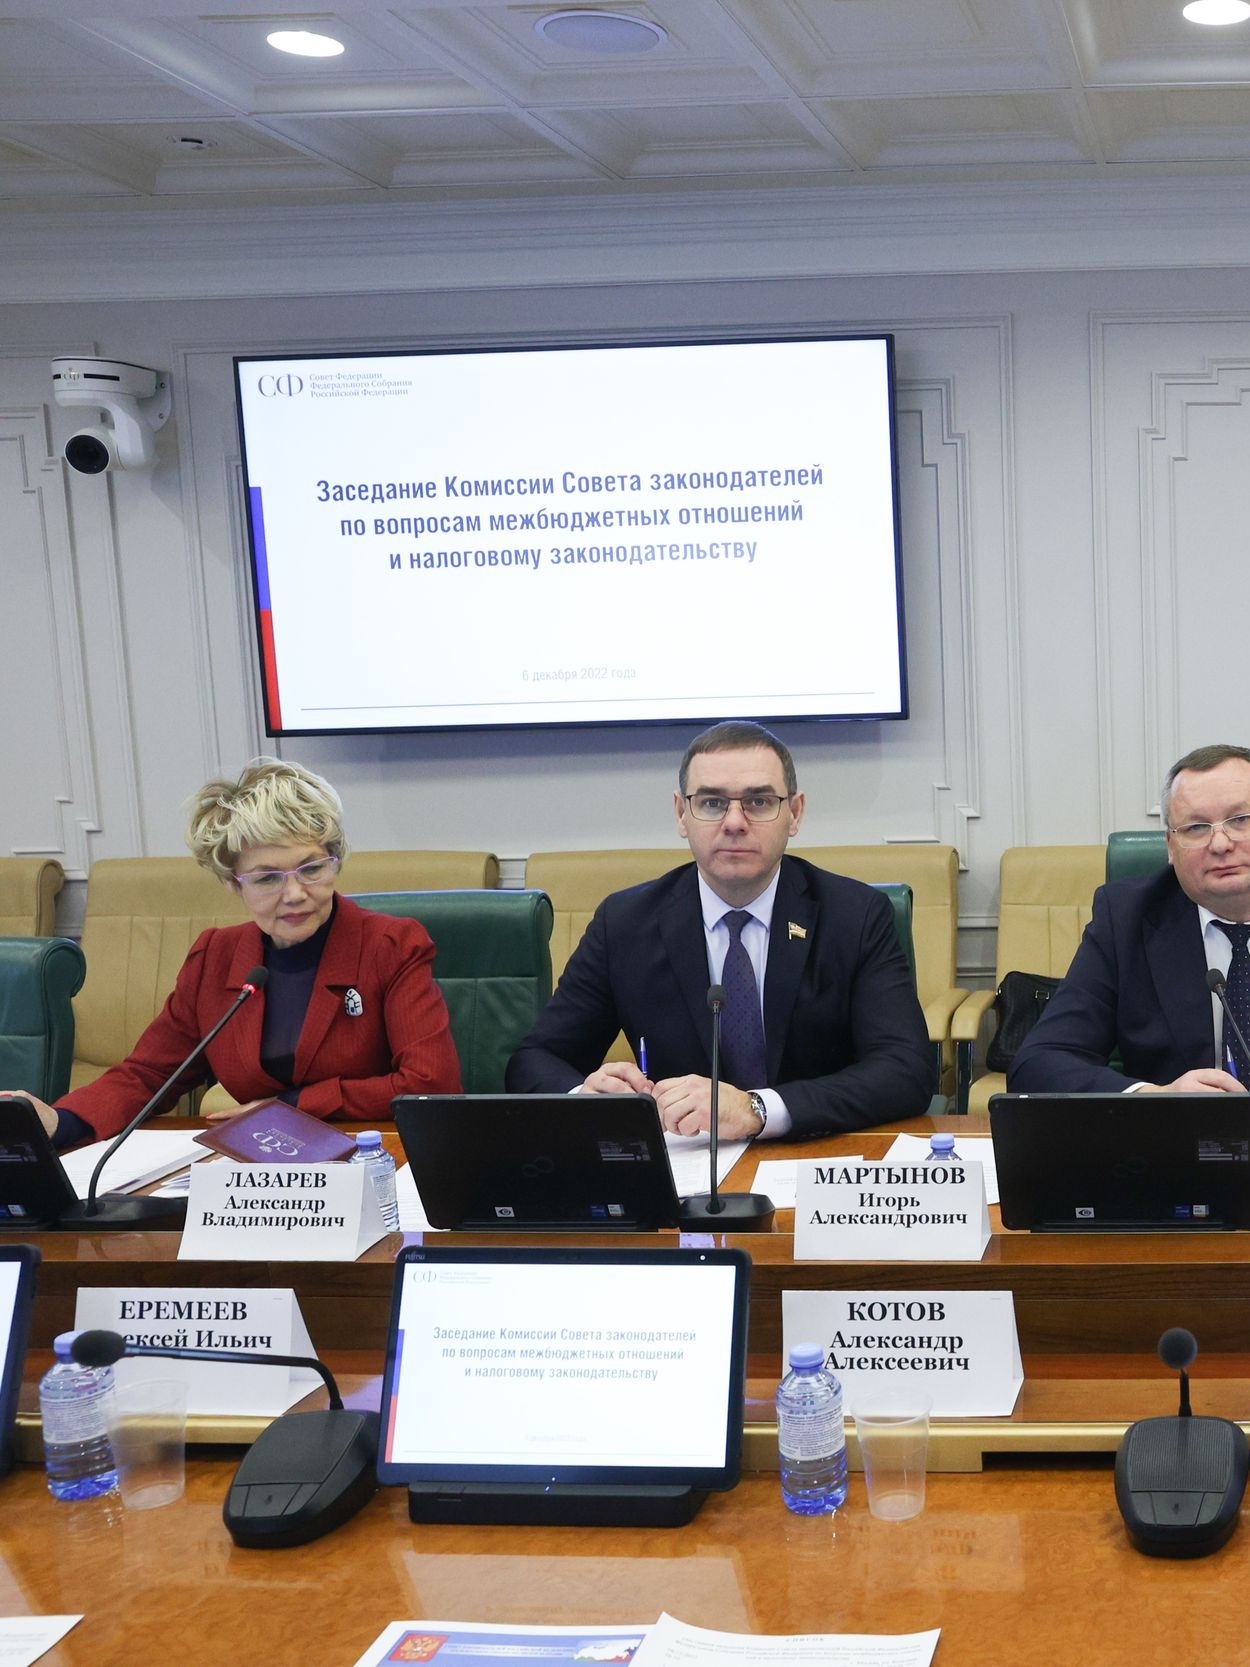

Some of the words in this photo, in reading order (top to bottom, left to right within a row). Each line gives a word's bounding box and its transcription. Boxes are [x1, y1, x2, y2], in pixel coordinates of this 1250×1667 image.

[258, 374, 303, 396] СФ
[317, 480, 436, 503] Заседание
[445, 476, 553, 497] Комиссии
[563, 472, 641, 493] Совета
[650, 464, 822, 491] законодателей
[341, 519, 365, 535] по
[374, 516, 480, 538] вопросам
[490, 508, 670, 532] межбюджетных
[679, 500, 802, 524] отношений
[390, 554, 401, 569] и
[410, 549, 541, 569] налоговому
[550, 542, 756, 565] законодательству
[522, 670, 530, 681] 6
[532, 669, 577, 682] декабря
[581, 667, 608, 679] 2022
[611, 669, 636, 680] года
[226, 1172, 326, 1187] ЛАЗАРЕВ
[815, 1167, 965, 1184] МАРТЫНОВ
[225, 1196, 325, 1213] Александр
[860, 1193, 920, 1211] Игорь
[202, 1212, 344, 1230] Владимирович
[810, 1210, 966, 1228] Александрович
[120, 1301, 247, 1320] ЕРЕМЕЕВ
[848, 1302, 945, 1321] КОТОВ
[122, 1329, 188, 1348] ексей
[195, 1330, 272, 1348] Ильич
[433, 1327, 496, 1341] Заседание
[500, 1328, 556, 1340] Комиссии
[561, 1328, 602, 1341] Совета
[606, 1330, 696, 1343] законодателей
[830, 1331, 963, 1356] Александр
[442, 1348, 456, 1358] по
[459, 1348, 516, 1360] вопросам
[520, 1347, 615, 1360] межбюджетных
[619, 1349, 684, 1360] отношений
[824, 1352, 969, 1370] Алексеевич
[465, 1368, 471, 1376] и
[475, 1368, 545, 1380] налоговому
[548, 1368, 658, 1381] законодательству
